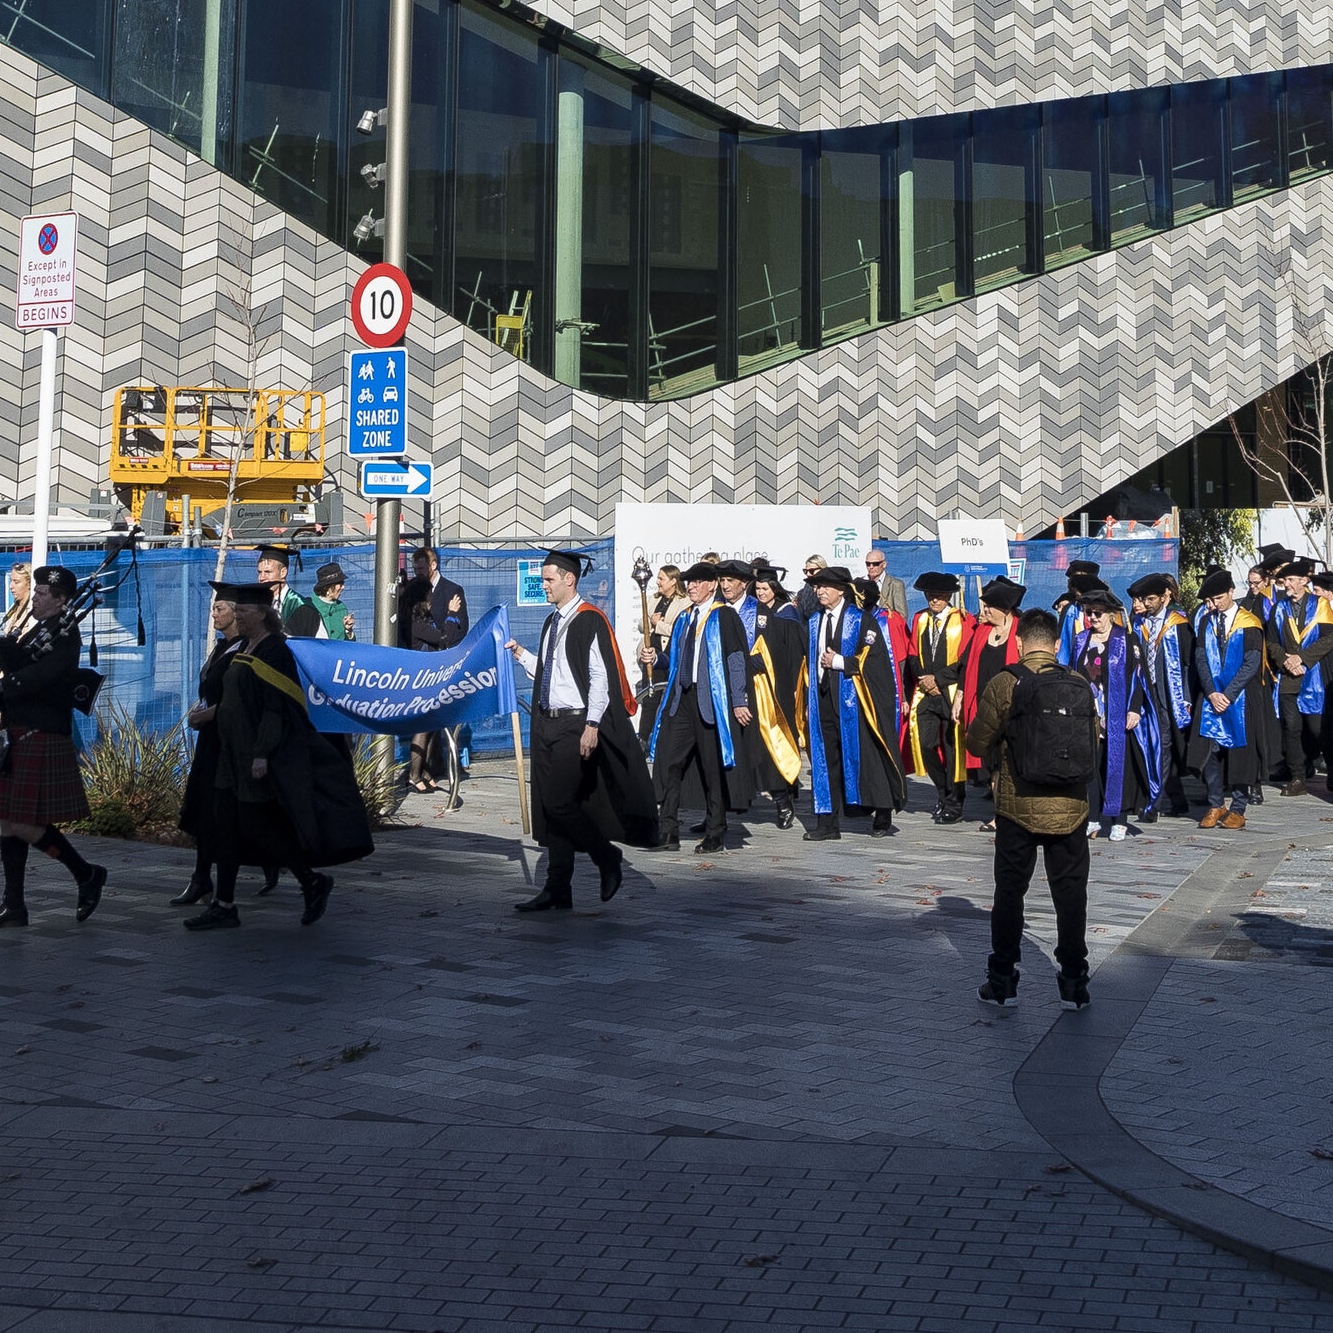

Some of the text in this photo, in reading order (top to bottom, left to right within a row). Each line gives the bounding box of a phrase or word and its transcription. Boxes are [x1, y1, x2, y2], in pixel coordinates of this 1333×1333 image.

[28, 259, 67, 272] Except in
[23, 271, 71, 287] Signposted
[34, 287, 59, 297] Areas
[370, 289, 395, 320] 10
[23, 306, 67, 322] BEGINS
[355, 408, 399, 427] SHARED
[362, 430, 392, 448] ZONE
[373, 474, 405, 483] ONE WAY
[961, 537, 984, 547] PhD's
[632, 546, 660, 565] Our
[832, 544, 860, 558] Te Pae
[332, 659, 410, 691] Lincoln
